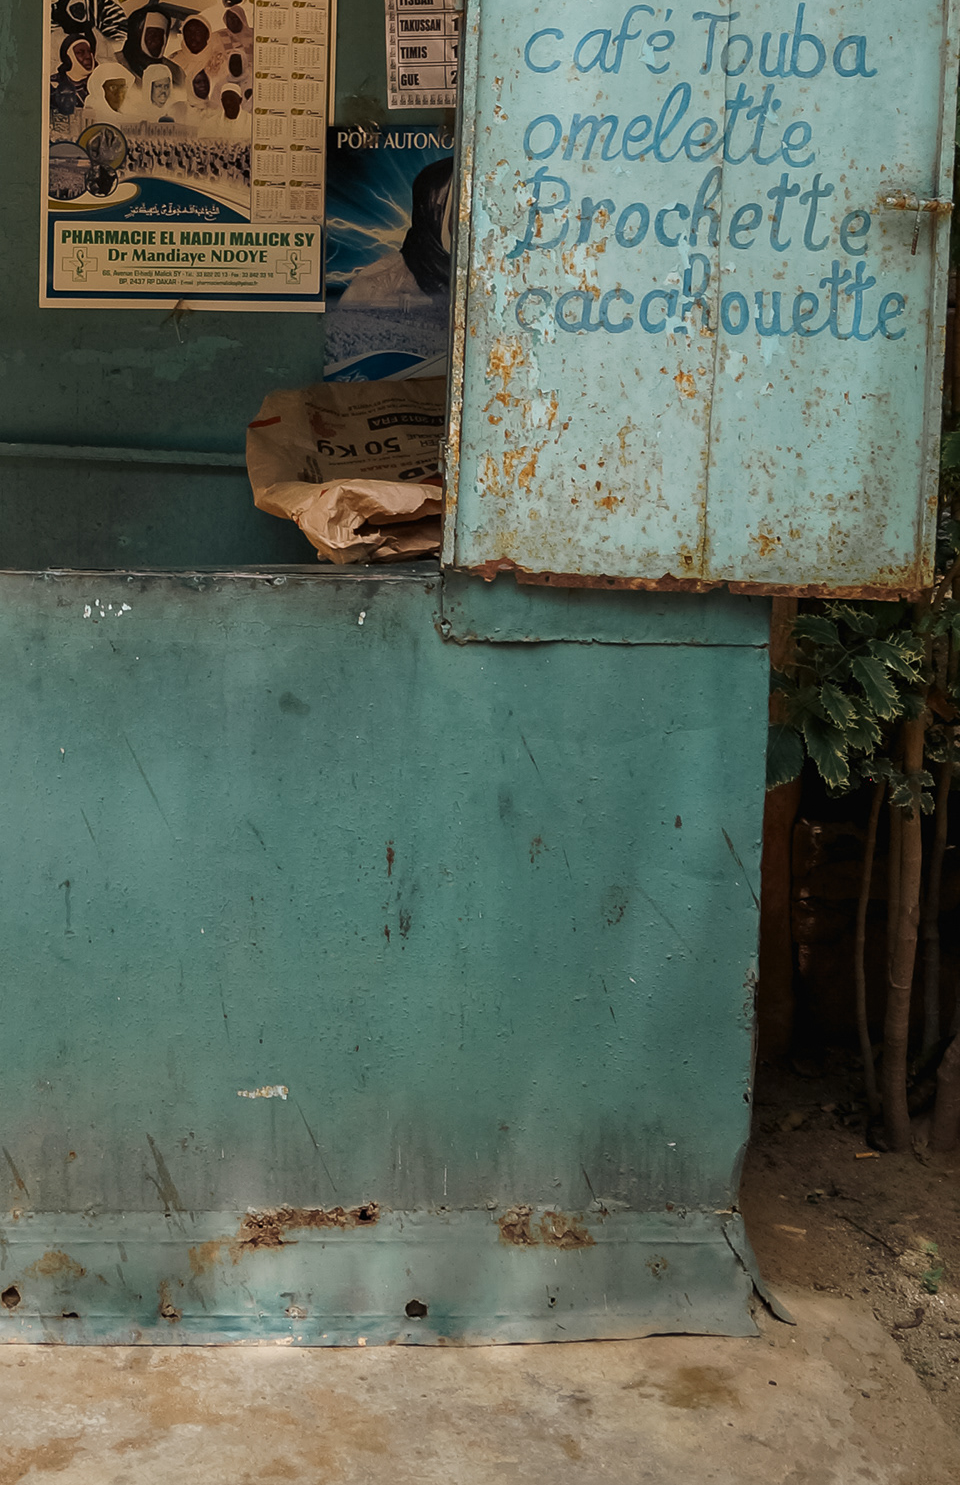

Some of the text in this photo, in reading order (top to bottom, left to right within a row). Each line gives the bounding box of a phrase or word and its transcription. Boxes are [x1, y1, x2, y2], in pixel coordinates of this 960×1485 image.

[399, 19, 442, 32] TAKUSSAN
[523, 1, 879, 79] café Touba
[400, 46, 428, 59] TIMIS
[400, 73, 420, 86] GUE
[522, 82, 816, 168] omelette
[337, 131, 381, 149] PORT
[506, 165, 873, 260] Brochette
[60, 229, 315, 248] PHARMACIE EL HADJI MALICK SY
[107, 248, 268, 266] Dr Mandiaye NDOYE
[515, 252, 907, 342] cacahouette
[316, 439, 358, 459] Kg
[364, 436, 401, 455] 50
